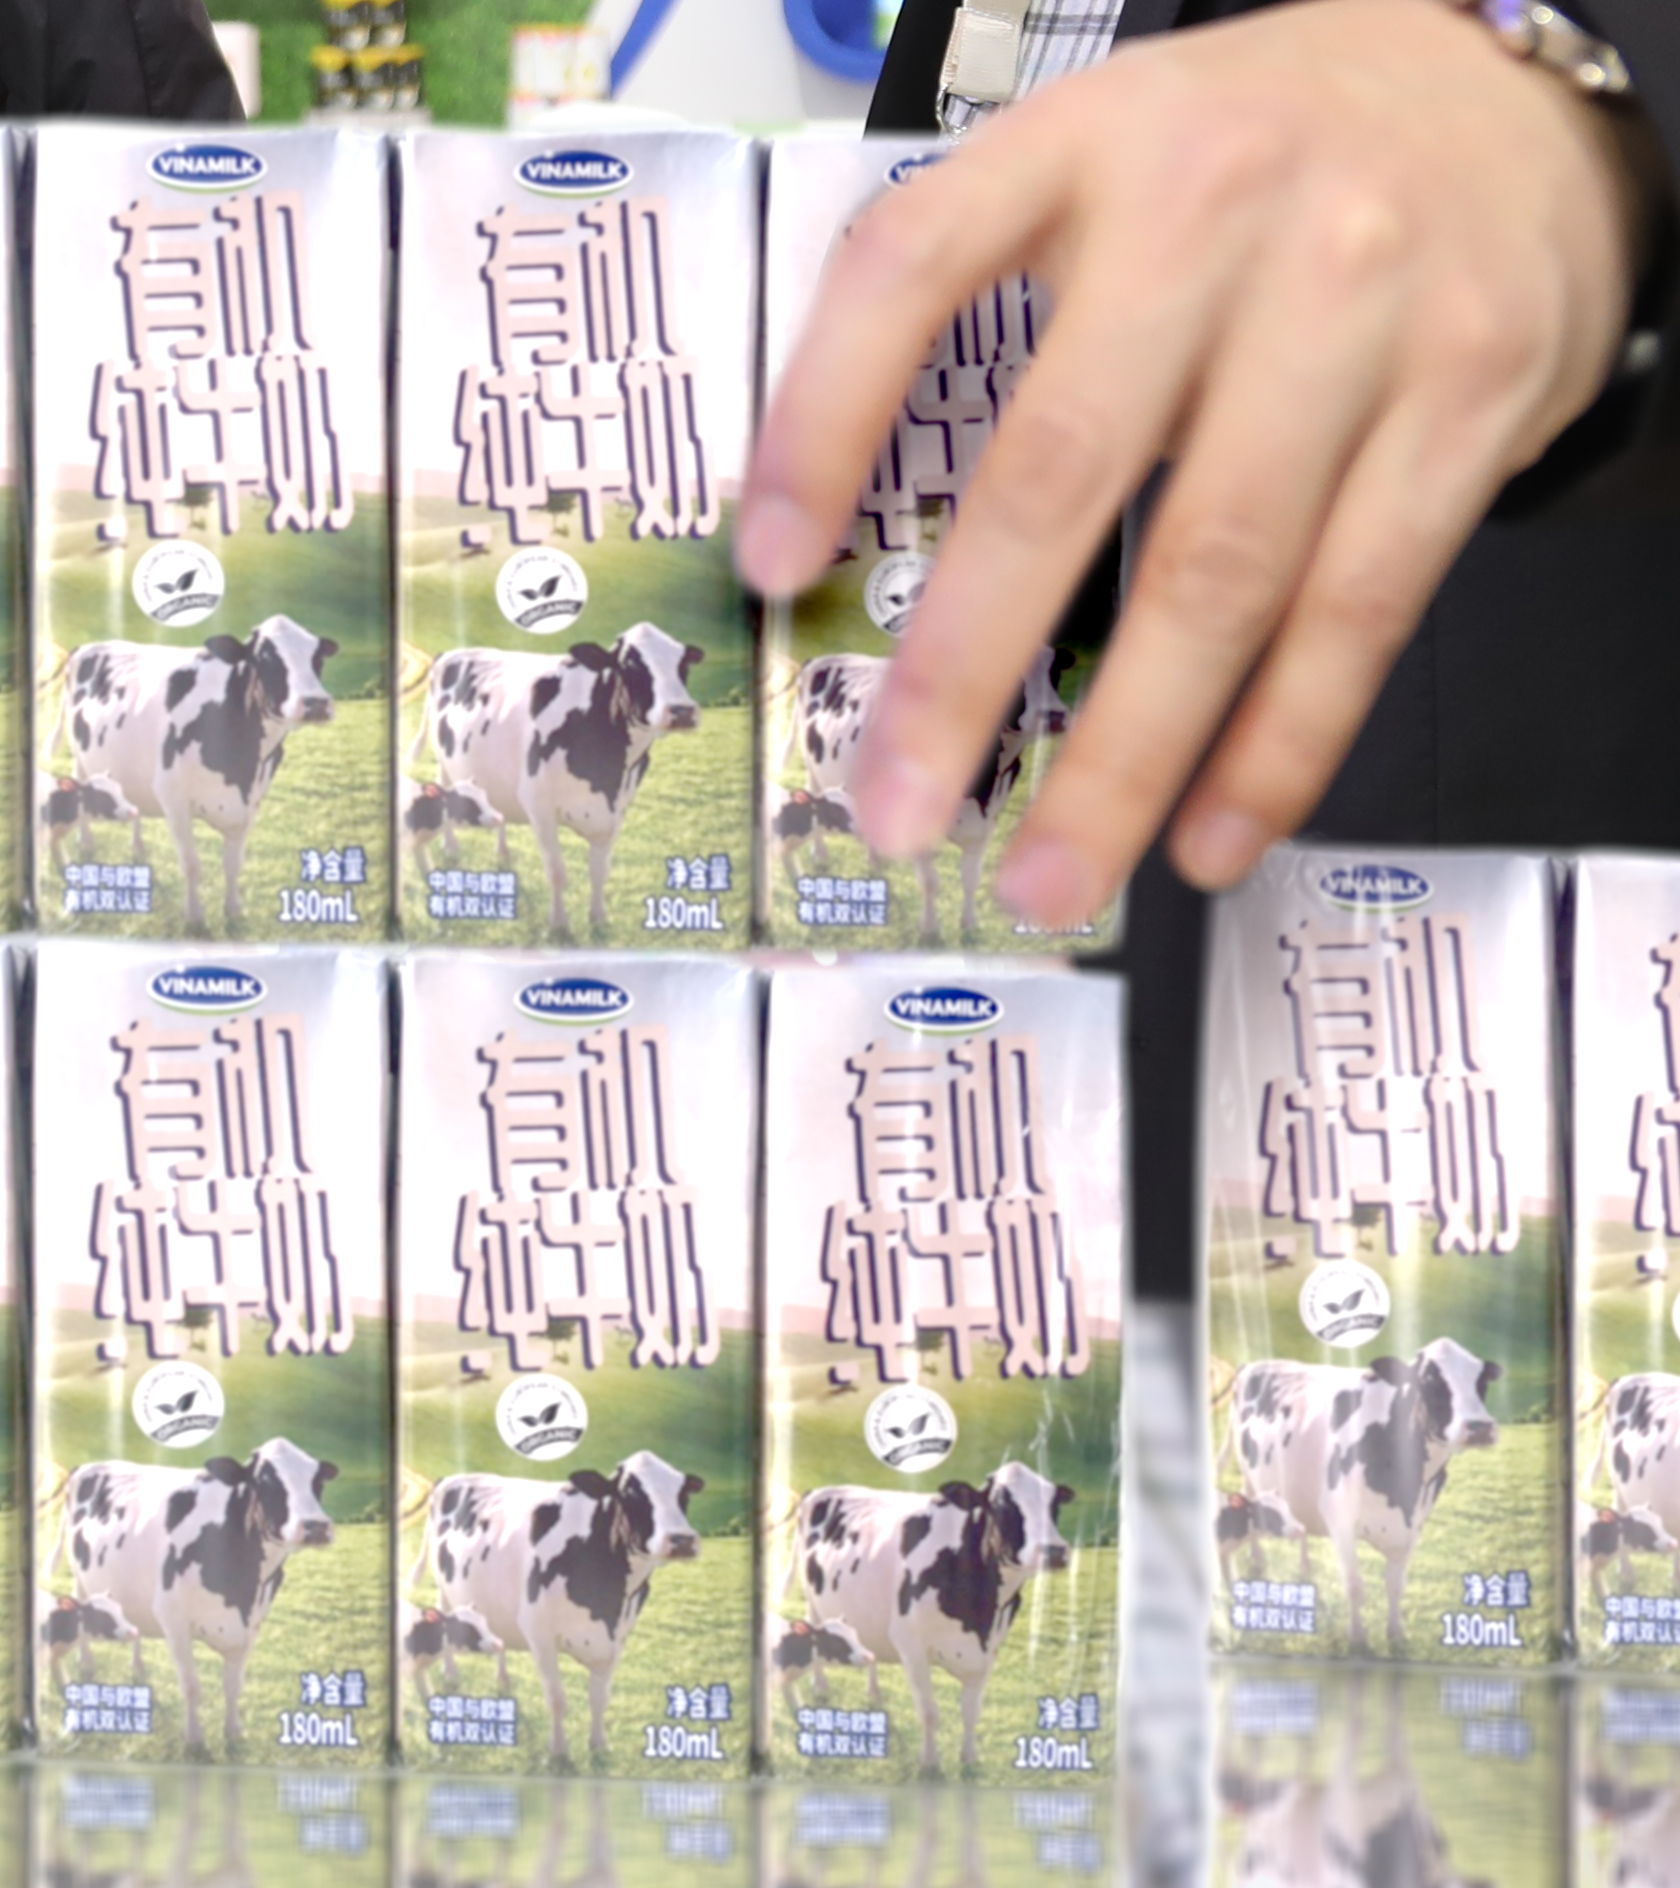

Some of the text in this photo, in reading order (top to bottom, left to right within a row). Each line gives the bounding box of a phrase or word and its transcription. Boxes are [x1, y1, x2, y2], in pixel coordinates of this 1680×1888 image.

[109, 192, 314, 362] 有机
[475, 194, 685, 367] 有机
[88, 354, 354, 542] 纯牛奶
[453, 357, 720, 549] 纯牛奶
[64, 864, 150, 888] 中国与欧盟
[301, 847, 366, 882] 净含量
[667, 855, 730, 890] 净含量
[429, 871, 516, 895] 中国与欧盟
[798, 877, 886, 902] 中国与欧盟
[279, 889, 358, 922] 180mL
[644, 897, 723, 929] 180mL
[1278, 912, 1481, 1085] 有机
[109, 1013, 314, 1183] 有机
[475, 1021, 685, 1194] 有机
[845, 1033, 1055, 1204] 有机
[1258, 1074, 1519, 1261] 纯牛奶
[88, 1175, 354, 1363] 纯牛奶
[453, 1184, 720, 1376] 纯牛奶
[821, 1194, 1090, 1385] 纯牛奶
[1233, 1582, 1315, 1607] 中国与欧盟
[1464, 1572, 1529, 1607] 净含量
[1442, 1613, 1522, 1645] 180mL
[64, 1684, 150, 1708] 中国与欧盟
[301, 1670, 366, 1705] 净含量
[667, 1684, 730, 1719] 净含量
[429, 1697, 516, 1721] 中国与欧盟
[798, 1709, 886, 1733] 中国与欧盟
[1038, 1694, 1100, 1729] 净含量
[279, 1712, 358, 1745] 180mL
[644, 1726, 723, 1758] 180mL
[1015, 1737, 1093, 1768] 180mL
